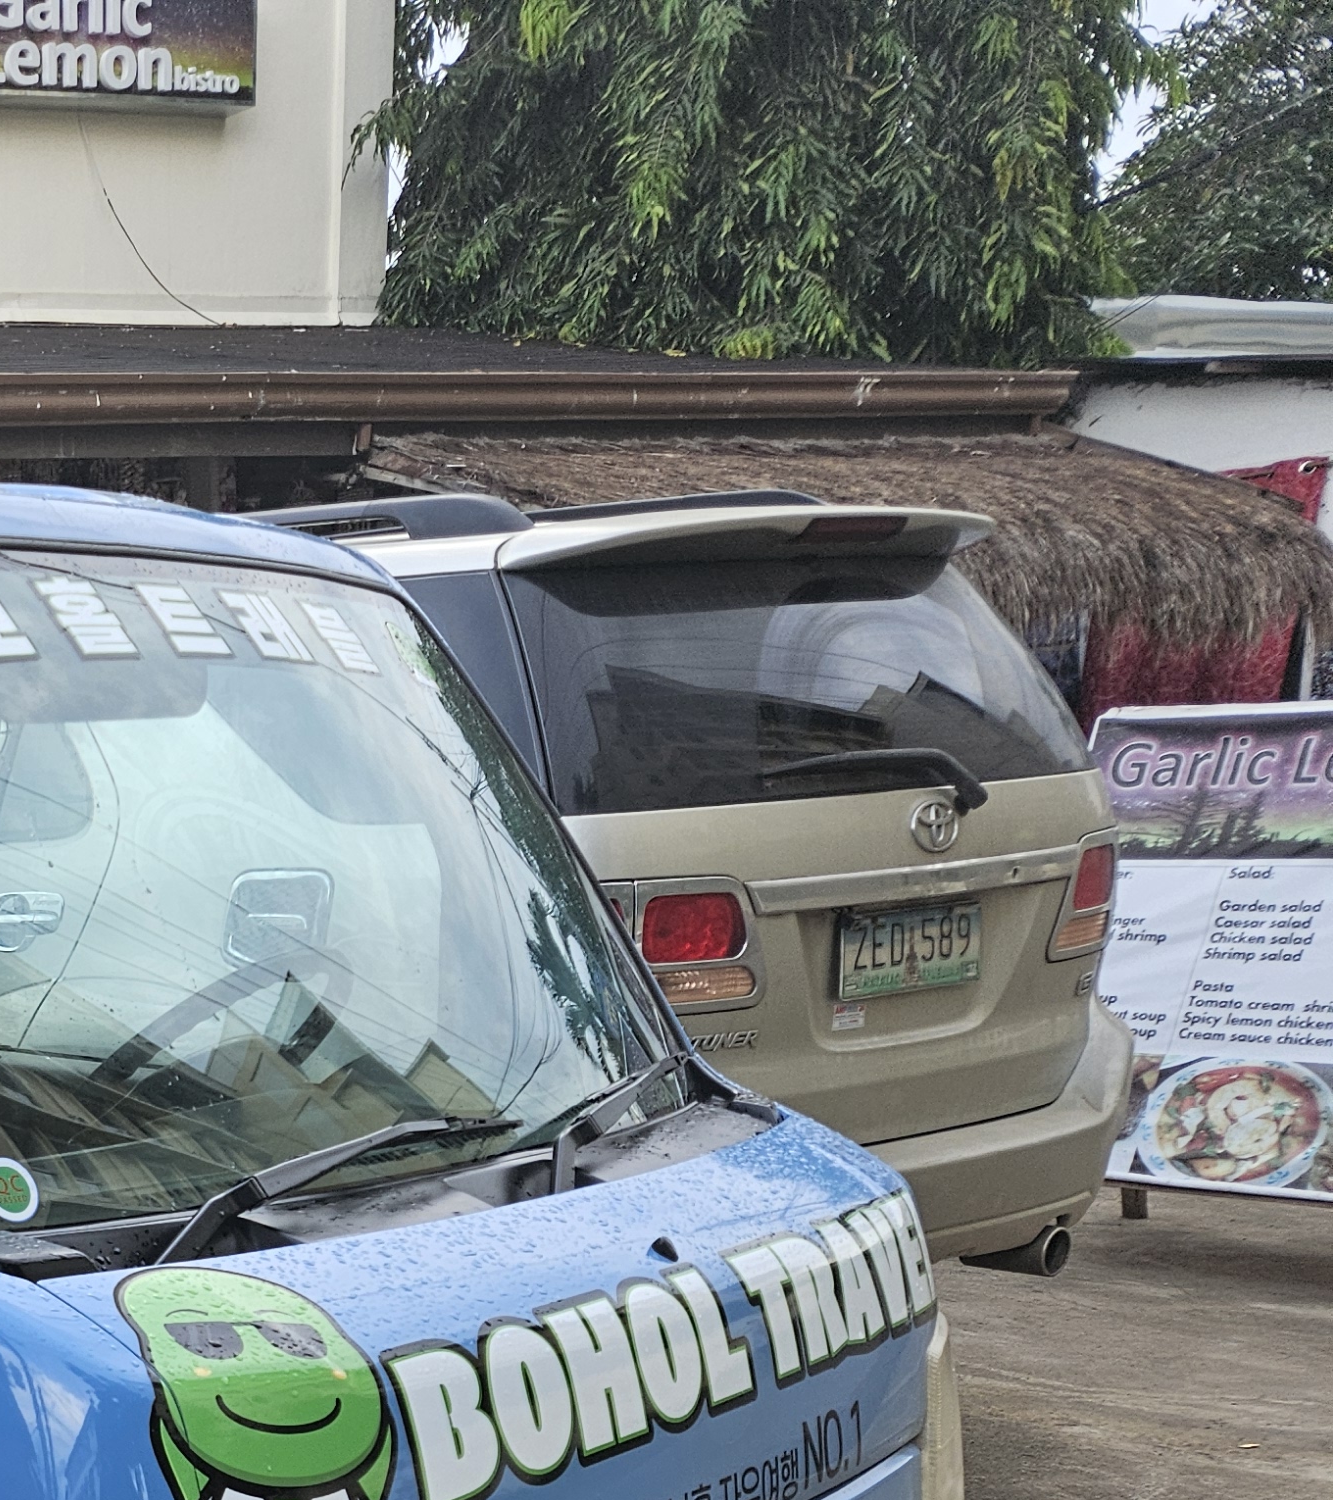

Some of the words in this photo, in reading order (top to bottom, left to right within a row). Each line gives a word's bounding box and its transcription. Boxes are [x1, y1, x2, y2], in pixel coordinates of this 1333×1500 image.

[174, 65, 240, 94] bistro
[1111, 736, 1277, 789] Garlic
[1219, 899, 1276, 912] Garden
[1280, 899, 1324, 912] salad
[1214, 916, 1266, 928] Caesar
[1269, 916, 1313, 929] salad
[853, 922, 905, 971] ZED
[921, 913, 971, 962] 589
[1117, 929, 1167, 946] shrimp
[1210, 931, 1266, 944] Chicken
[1270, 932, 1315, 945] salad
[1202, 947, 1256, 964] Shrimp
[1259, 949, 1304, 962] salad
[1192, 980, 1234, 992] Pasta
[1188, 995, 1243, 1009] Tomato
[1247, 1001, 1295, 1012] cream
[1302, 1000, 1333, 1013] shri
[1131, 1012, 1167, 1025] soup
[1182, 1011, 1222, 1028] Spicy
[1225, 1013, 1273, 1027] lemon
[1277, 1015, 1333, 1030] chicken
[692, 1030, 759, 1051] TUNER
[1178, 1027, 1226, 1041] Cream
[1229, 1033, 1272, 1043] sauce
[1277, 1032, 1333, 1047] chicken
[802, 1399, 863, 1491] NO.1
